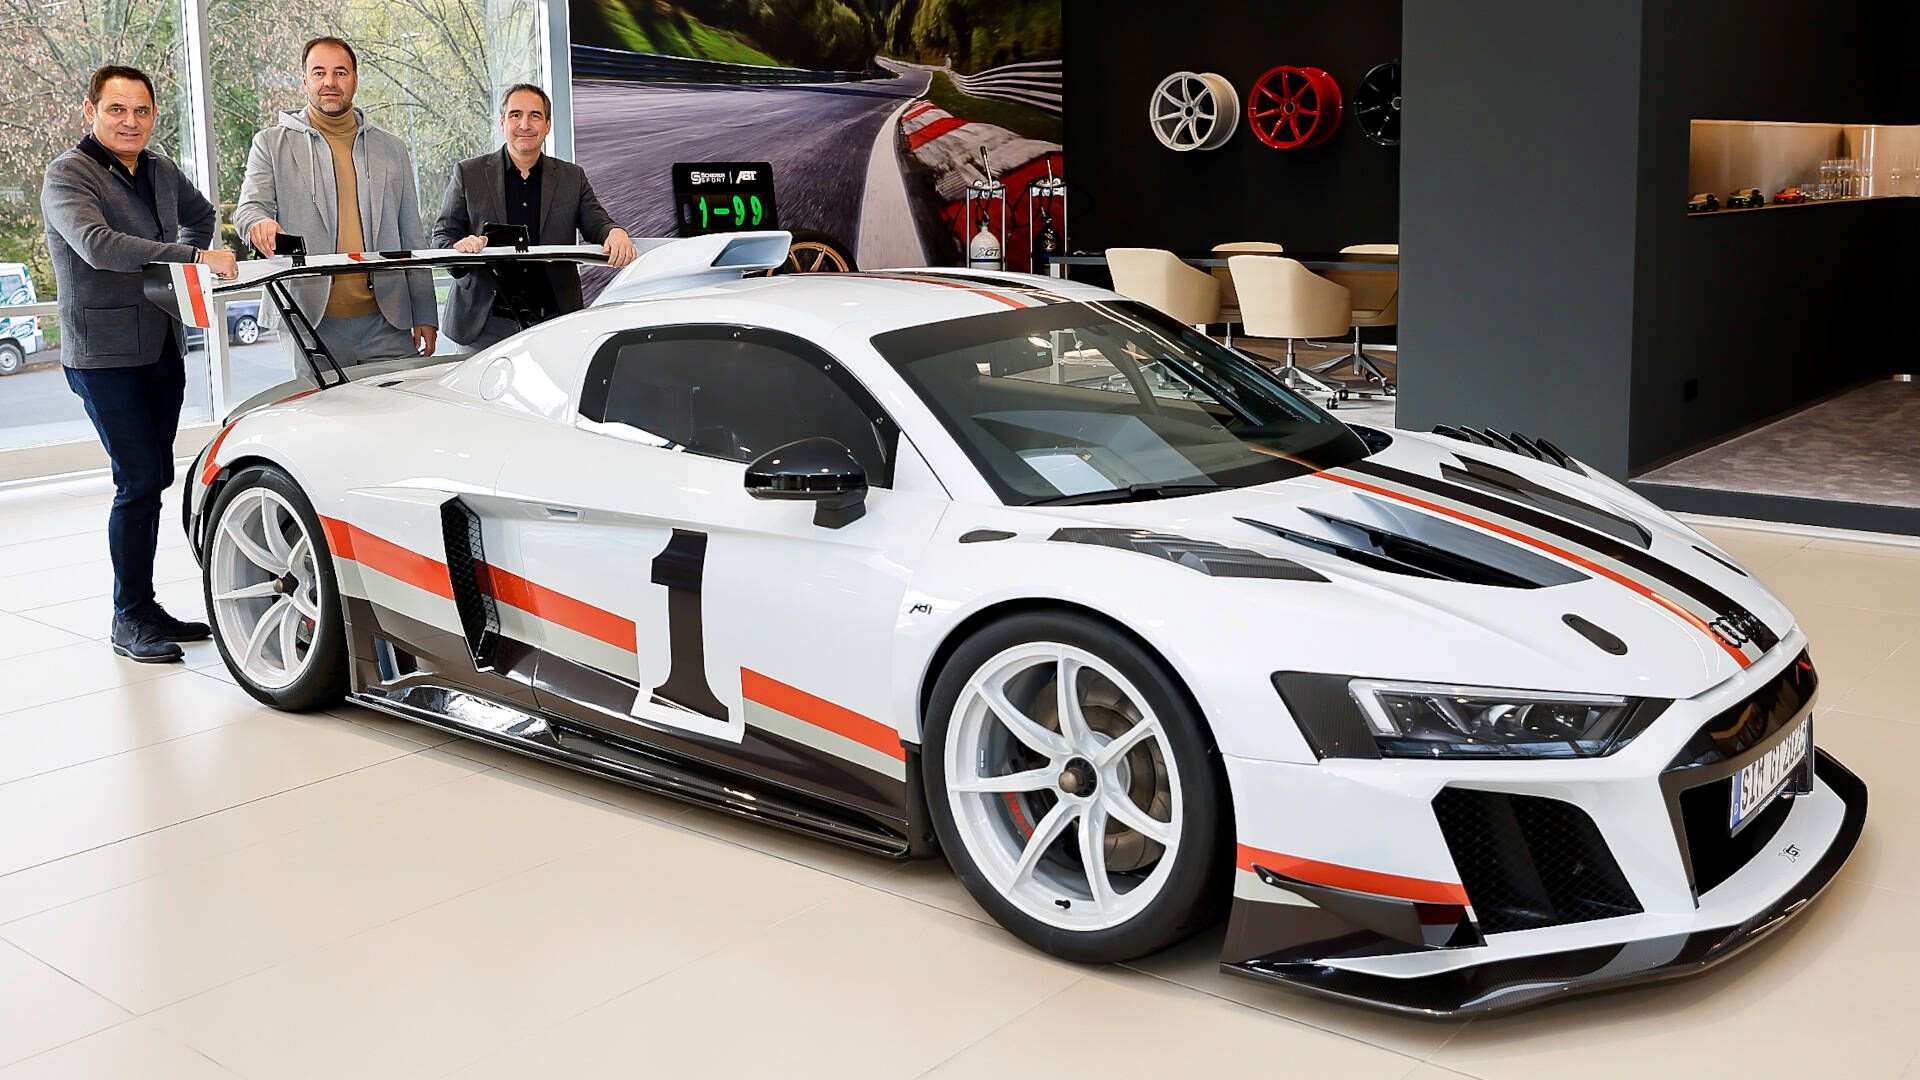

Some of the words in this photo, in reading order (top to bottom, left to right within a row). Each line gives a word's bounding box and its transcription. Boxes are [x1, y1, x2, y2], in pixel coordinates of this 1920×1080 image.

[735, 170, 758, 184] ABT
[699, 195, 763, 228] 1-99
[651, 527, 730, 723] 1
